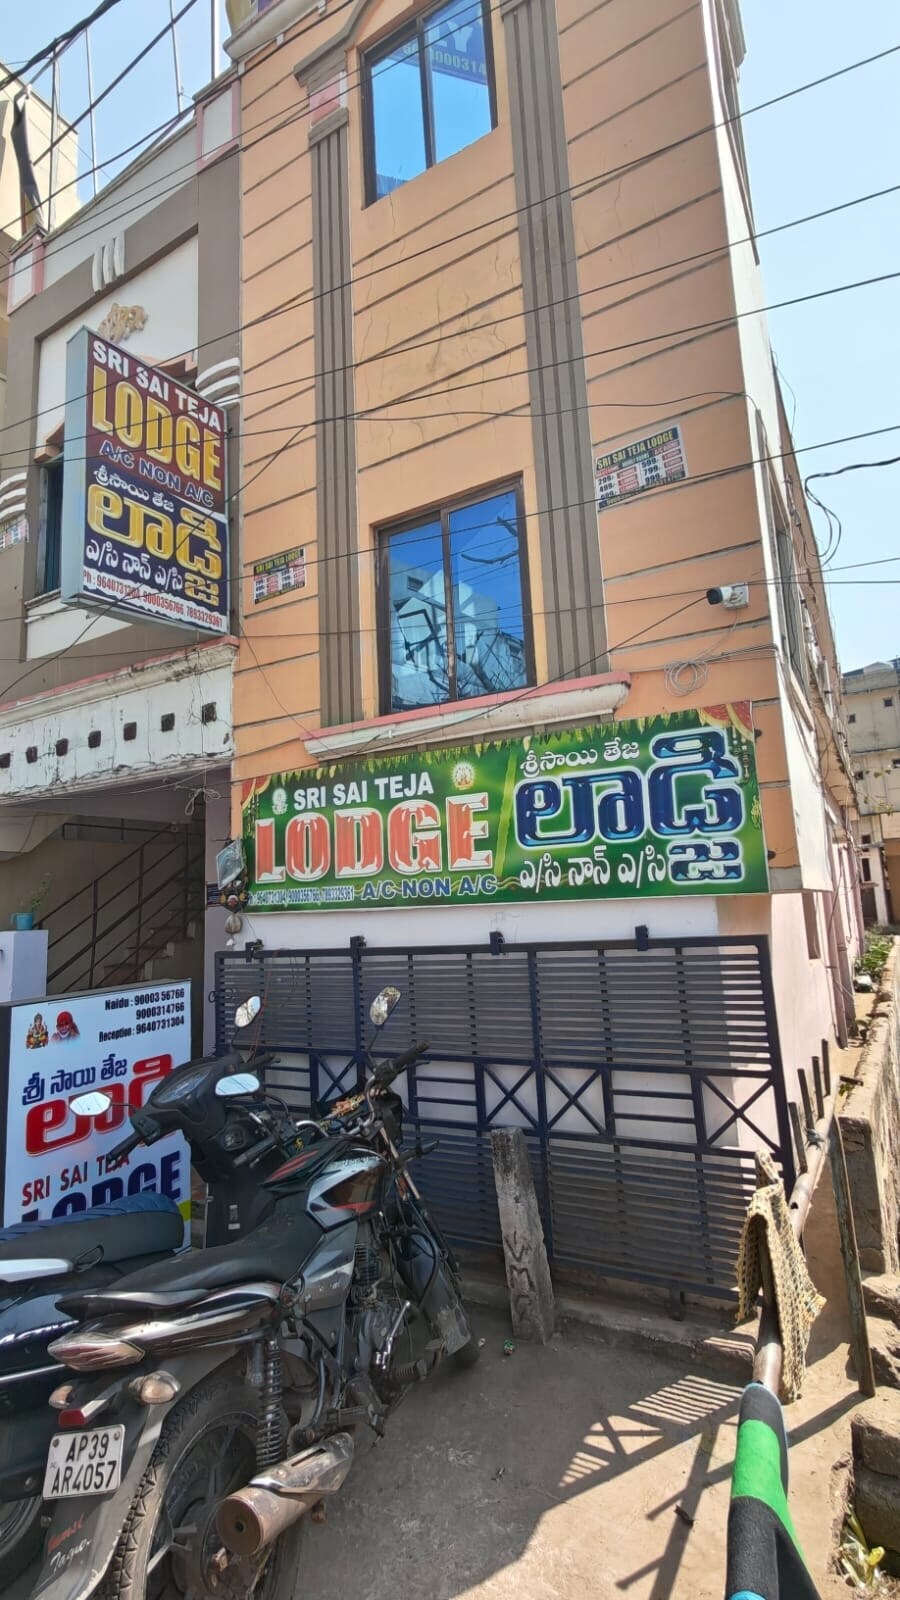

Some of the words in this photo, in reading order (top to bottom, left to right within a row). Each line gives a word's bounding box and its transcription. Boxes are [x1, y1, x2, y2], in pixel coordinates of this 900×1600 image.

[92, 340, 130, 379] SRI
[136, 366, 170, 401] SAI
[175, 389, 221, 433] TEJA
[91, 365, 222, 491] LODGE
[597, 457, 611, 470] SRI
[612, 450, 626, 463] SAI
[627, 442, 646, 457] TEJA
[647, 430, 674, 449] LODGE
[98, 439, 135, 470] A/C
[139, 460, 182, 491] NON
[185, 485, 214, 508] A/C
[603, 736, 641, 762] తేజ
[293, 786, 327, 812] SRI
[333, 780, 369, 807] SAI
[374, 771, 434, 801] TEJA
[254, 791, 493, 886] LODGE
[361, 880, 396, 901] A/C
[401, 876, 451, 898] NON
[457, 874, 498, 896] A/C
[105, 997, 129, 1011] Naidu
[136, 1002, 185, 1020] 9000314766
[99, 1026, 132, 1043] Reception
[136, 1015, 185, 1035] 9640731304
[50, 1065, 96, 1095] సాయి
[100, 1053, 128, 1081] తేజ
[22, 1175, 51, 1207] SRI
[60, 1161, 88, 1192] SAI
[65, 1432, 110, 1463] AP39
[51, 1460, 117, 1495] AR4057
